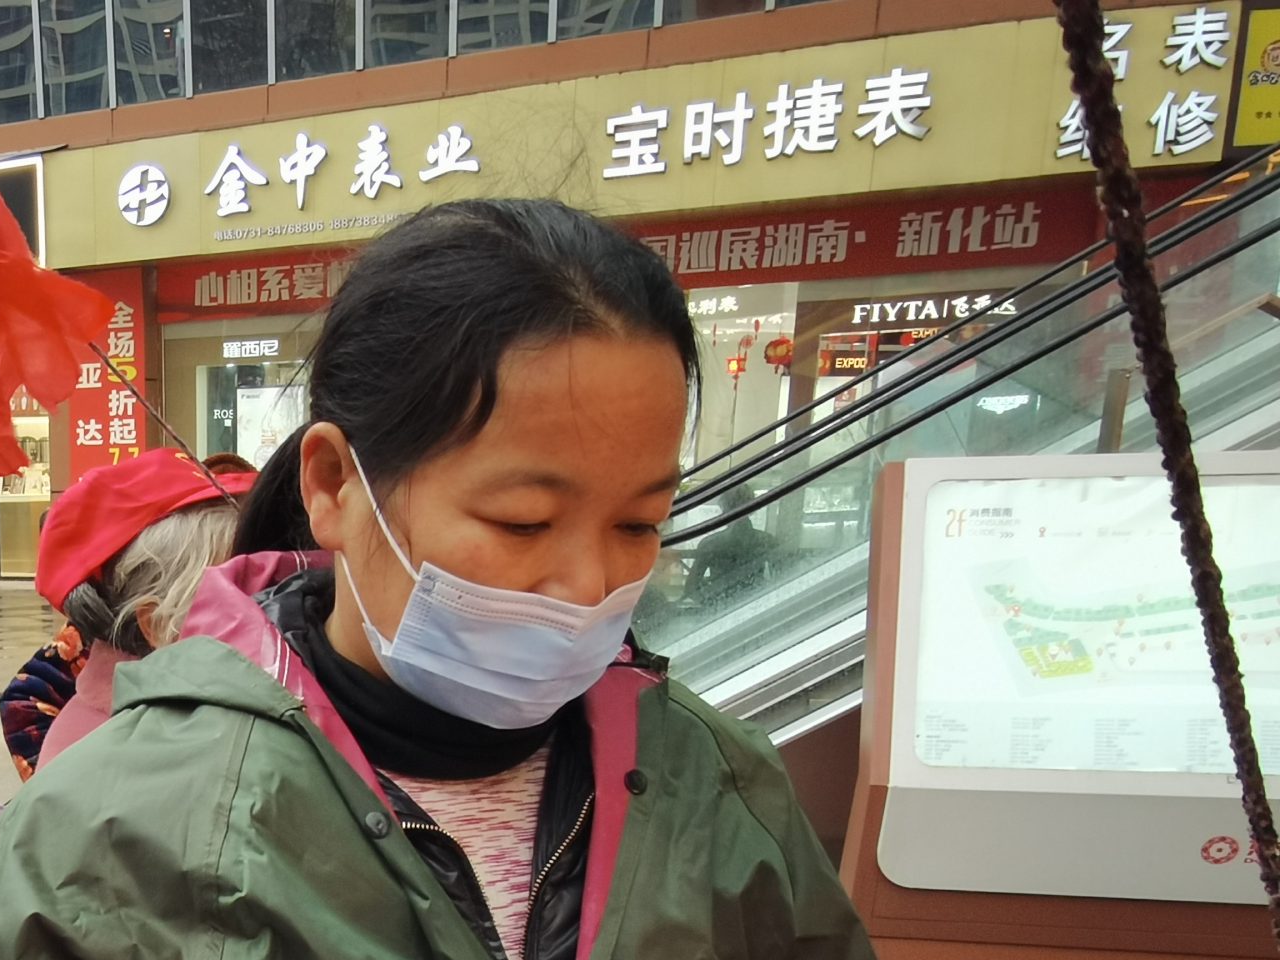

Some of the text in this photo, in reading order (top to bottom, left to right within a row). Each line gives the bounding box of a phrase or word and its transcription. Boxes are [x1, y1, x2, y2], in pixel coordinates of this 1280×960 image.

[602, 67, 933, 180] 宝时捷表
[204, 125, 481, 217] 金中表业
[895, 201, 1042, 259] 新化站
[851, 299, 939, 324] FIYTA
[107, 301, 138, 445] 全场5折起
